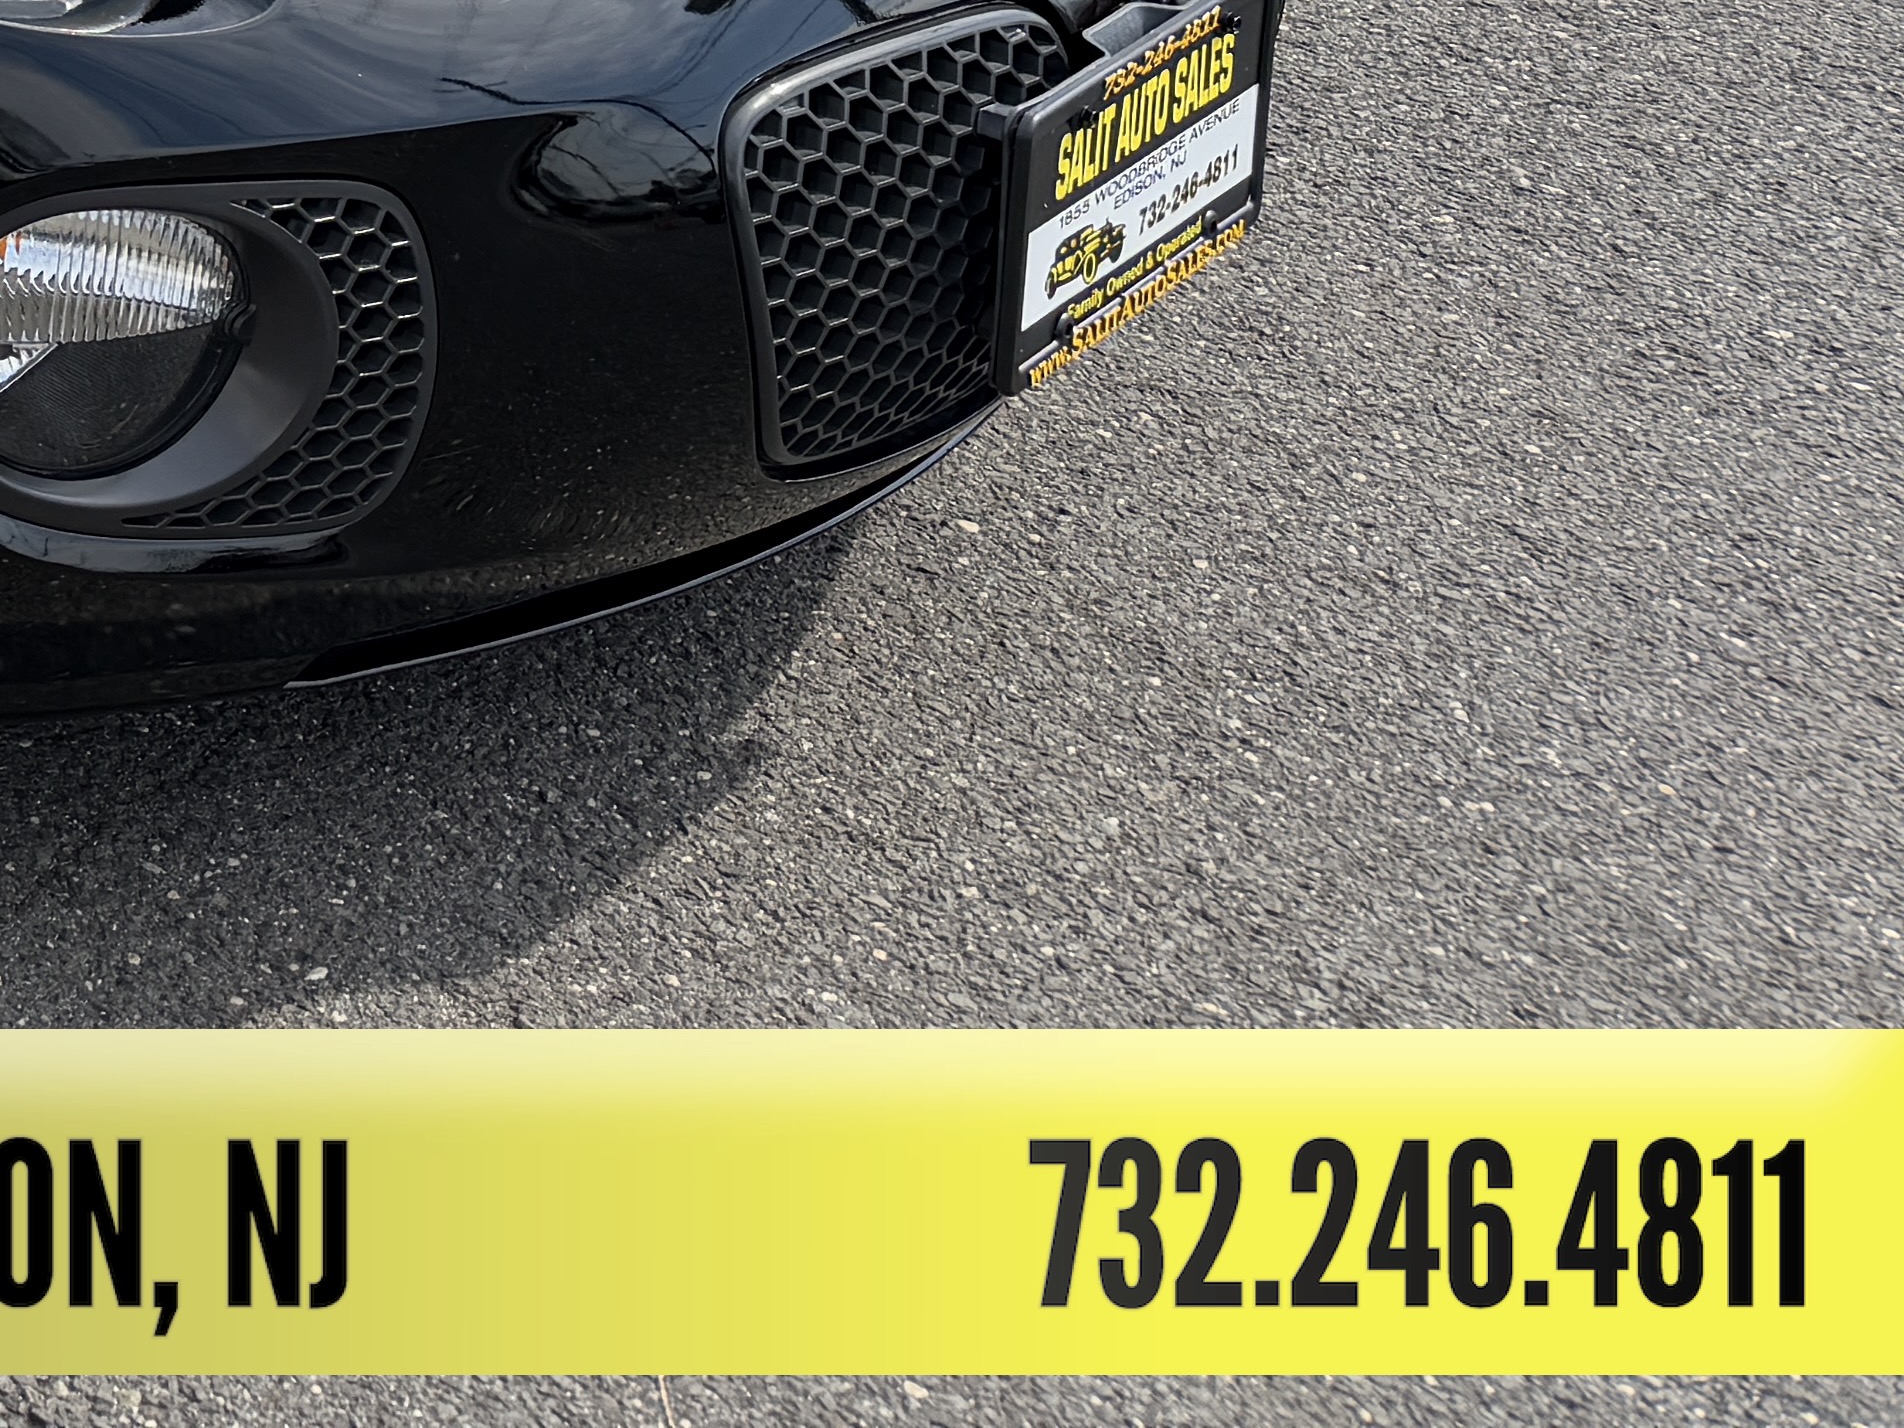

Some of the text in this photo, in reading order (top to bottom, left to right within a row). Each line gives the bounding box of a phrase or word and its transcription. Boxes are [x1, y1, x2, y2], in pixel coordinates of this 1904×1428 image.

[1103, 5, 1222, 101] 732-246-4811
[1056, 33, 1235, 200] SALIT AUTO SALES
[1095, 134, 1186, 206] WOODBRIDGE
[1188, 98, 1240, 145] AVENUE
[1113, 150, 1188, 210] EDISON, NJ
[1137, 143, 1239, 236] 732-246-4811
[1068, 215, 1203, 320] Family Owned & Operated
